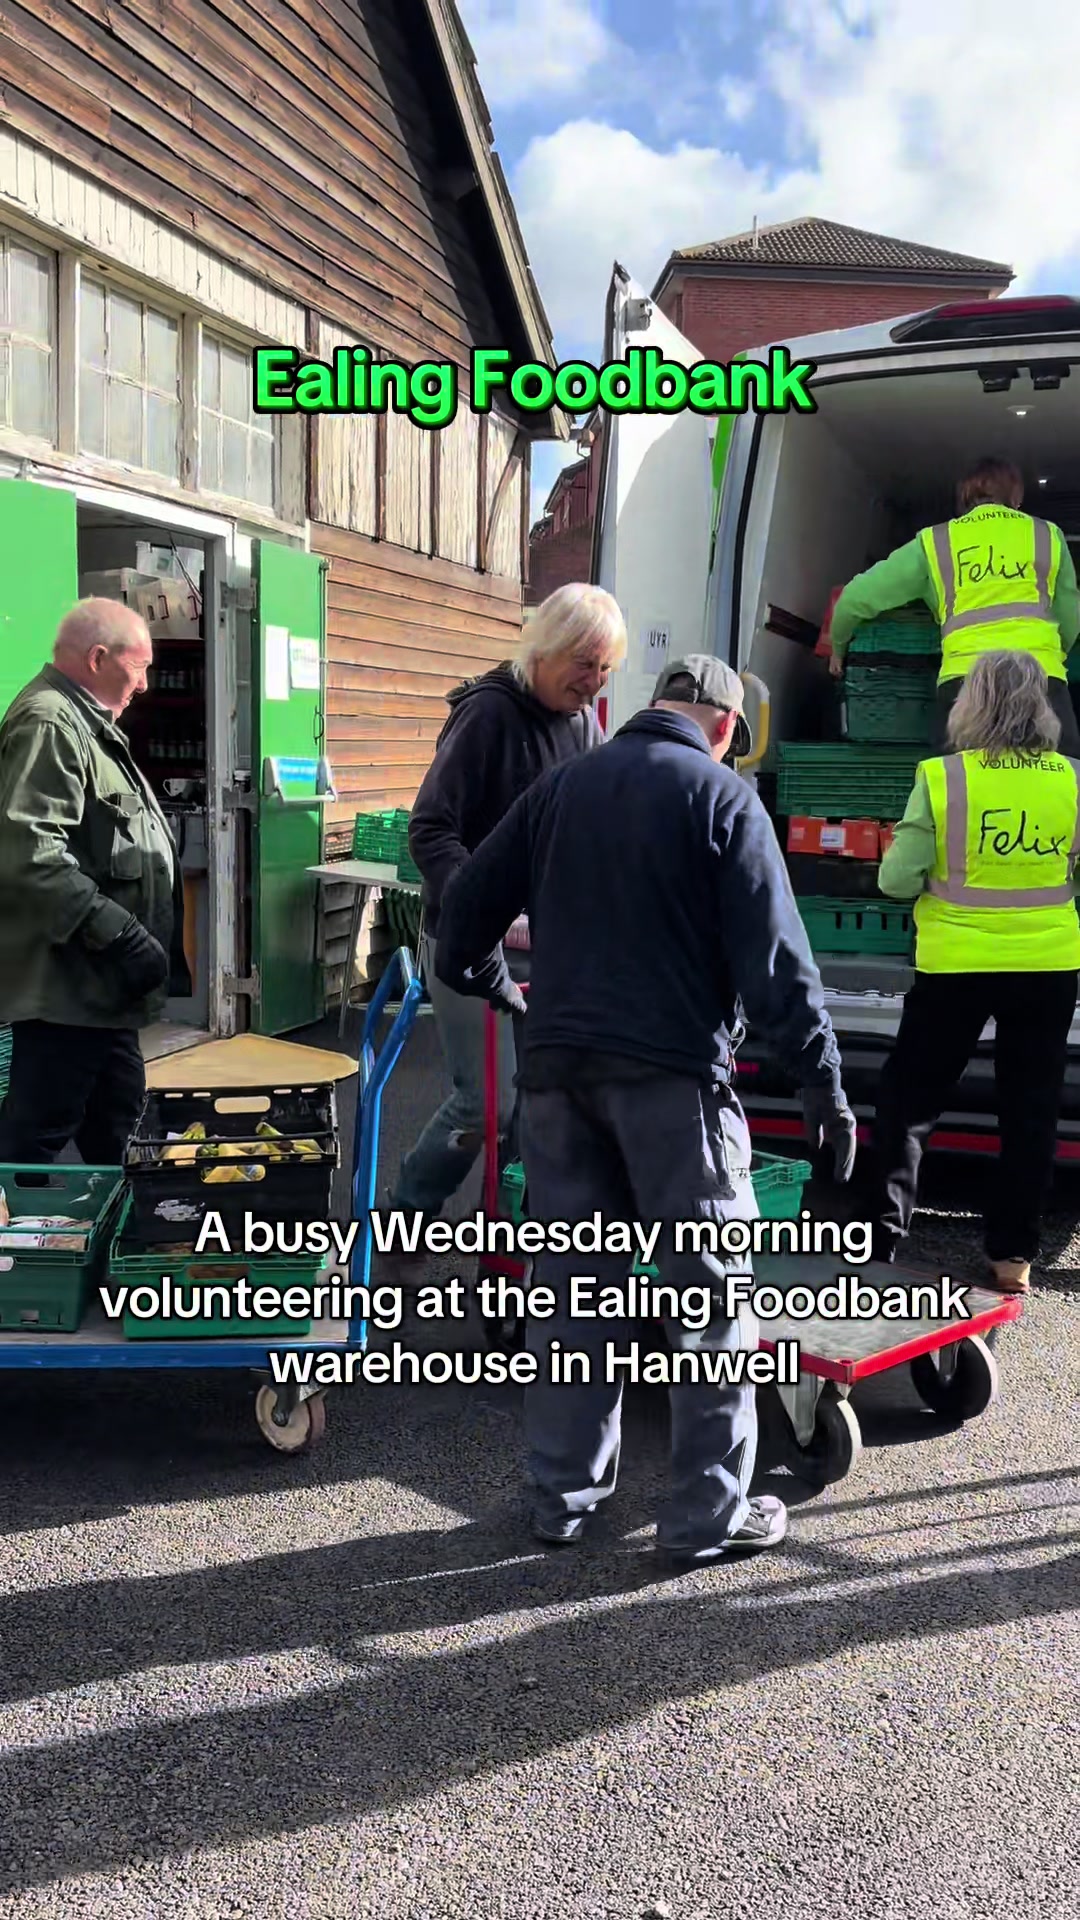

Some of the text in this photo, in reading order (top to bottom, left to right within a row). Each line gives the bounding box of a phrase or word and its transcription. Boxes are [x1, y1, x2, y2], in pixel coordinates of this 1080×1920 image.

[952, 511, 1026, 525] VOLUNTEER
[956, 545, 1029, 587] Felix
[978, 757, 1066, 773] VOLUNTEER
[978, 808, 1067, 856] Felix
